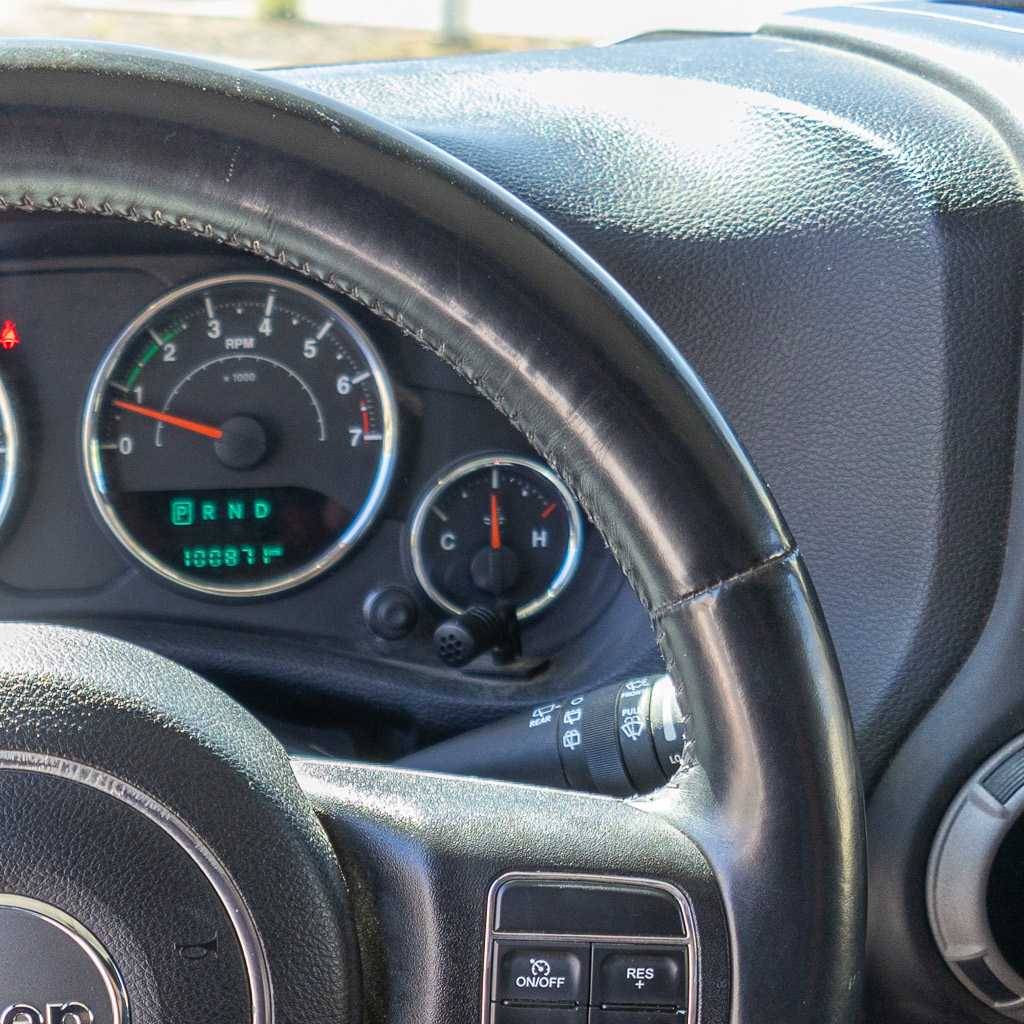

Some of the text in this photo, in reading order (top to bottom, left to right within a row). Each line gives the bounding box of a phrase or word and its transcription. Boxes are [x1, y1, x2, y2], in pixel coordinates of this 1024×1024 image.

[208, 320, 221, 339] 3
[258, 318, 272, 336] 4
[163, 344, 176, 362] 2
[225, 339, 255, 350] RPM
[303, 340, 317, 358] 5
[336, 376, 350, 395] 6
[133, 386, 143, 404] 1
[119, 437, 133, 455] 0
[349, 429, 362, 447] 7
[201, 504, 216, 520] R
[227, 503, 243, 520] N
[255, 502, 269, 519] D
[440, 533, 456, 551] C
[531, 530, 547, 548] H
[529, 714, 552, 728] REAR
[516, 976, 565, 989] ON/OFF
[626, 968, 654, 980] RES
